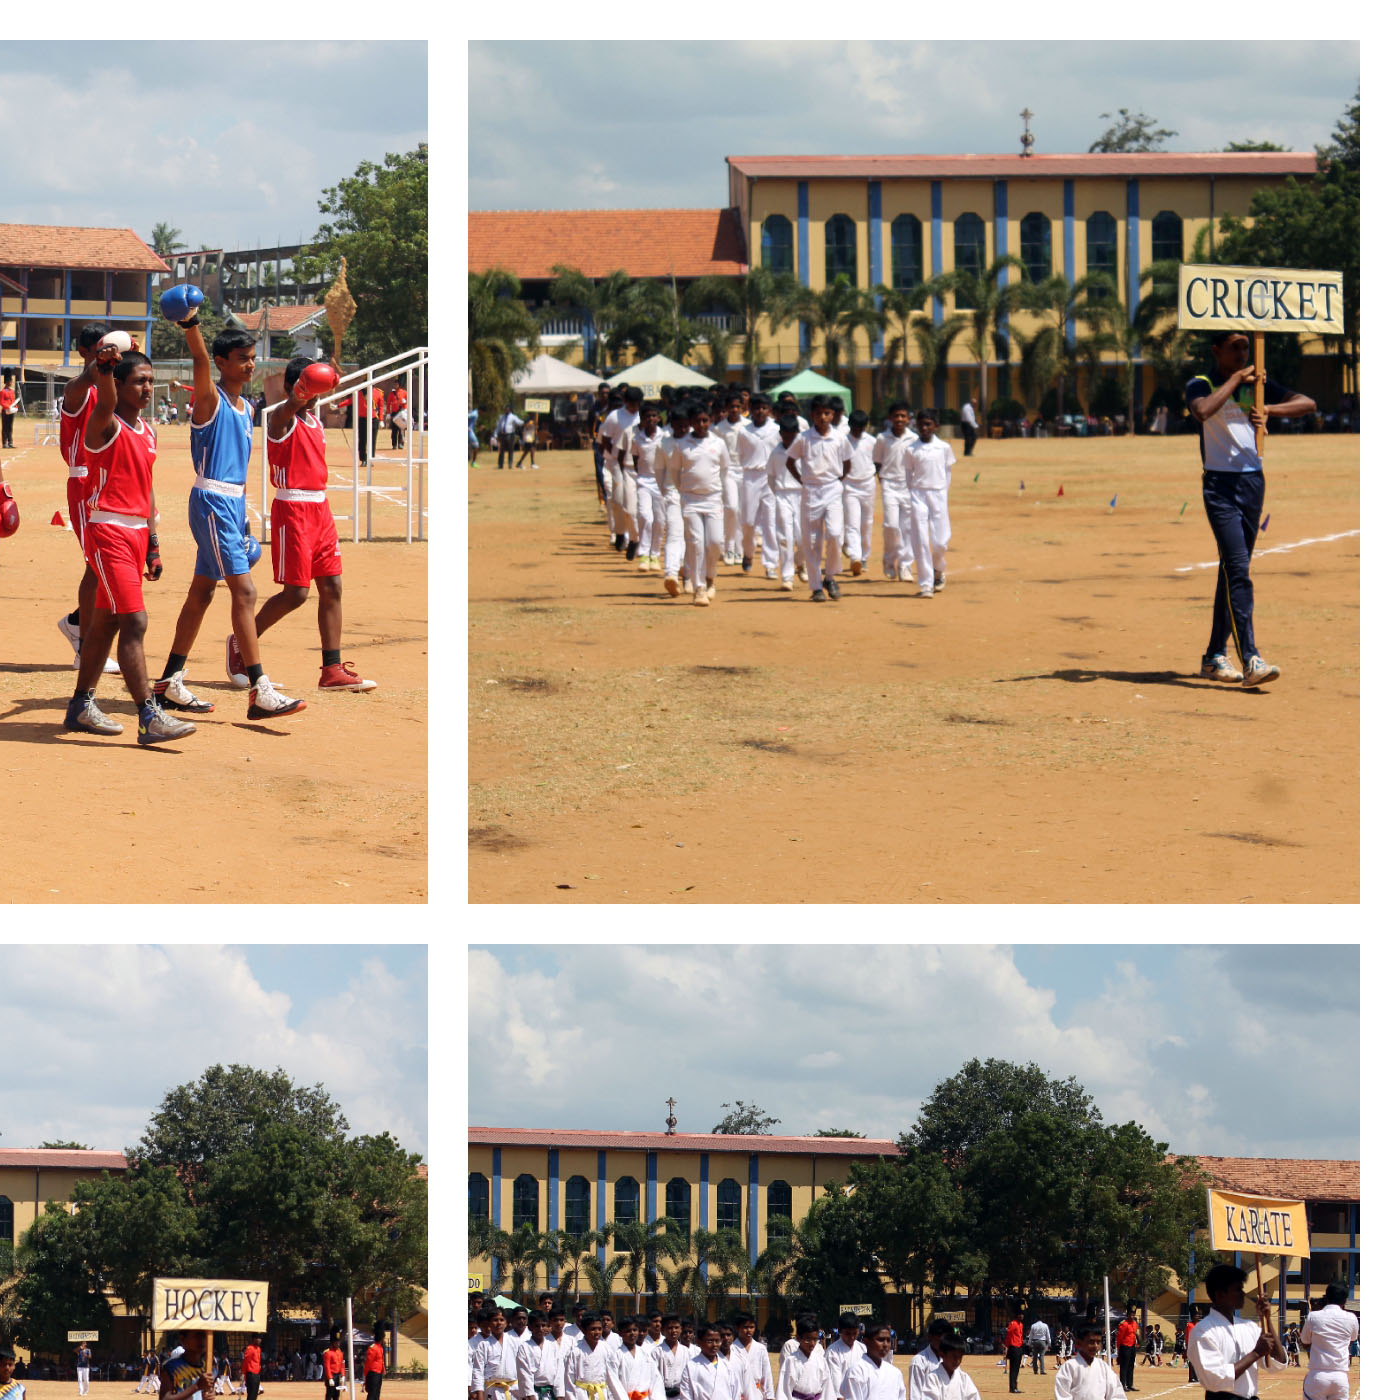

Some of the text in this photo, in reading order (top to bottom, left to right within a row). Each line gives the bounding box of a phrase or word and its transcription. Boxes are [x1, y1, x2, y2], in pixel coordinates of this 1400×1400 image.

[1186, 277, 1338, 322] CRICKET
[1226, 1206, 1293, 1247] KARATE
[164, 1289, 261, 1322] HOCKEY
